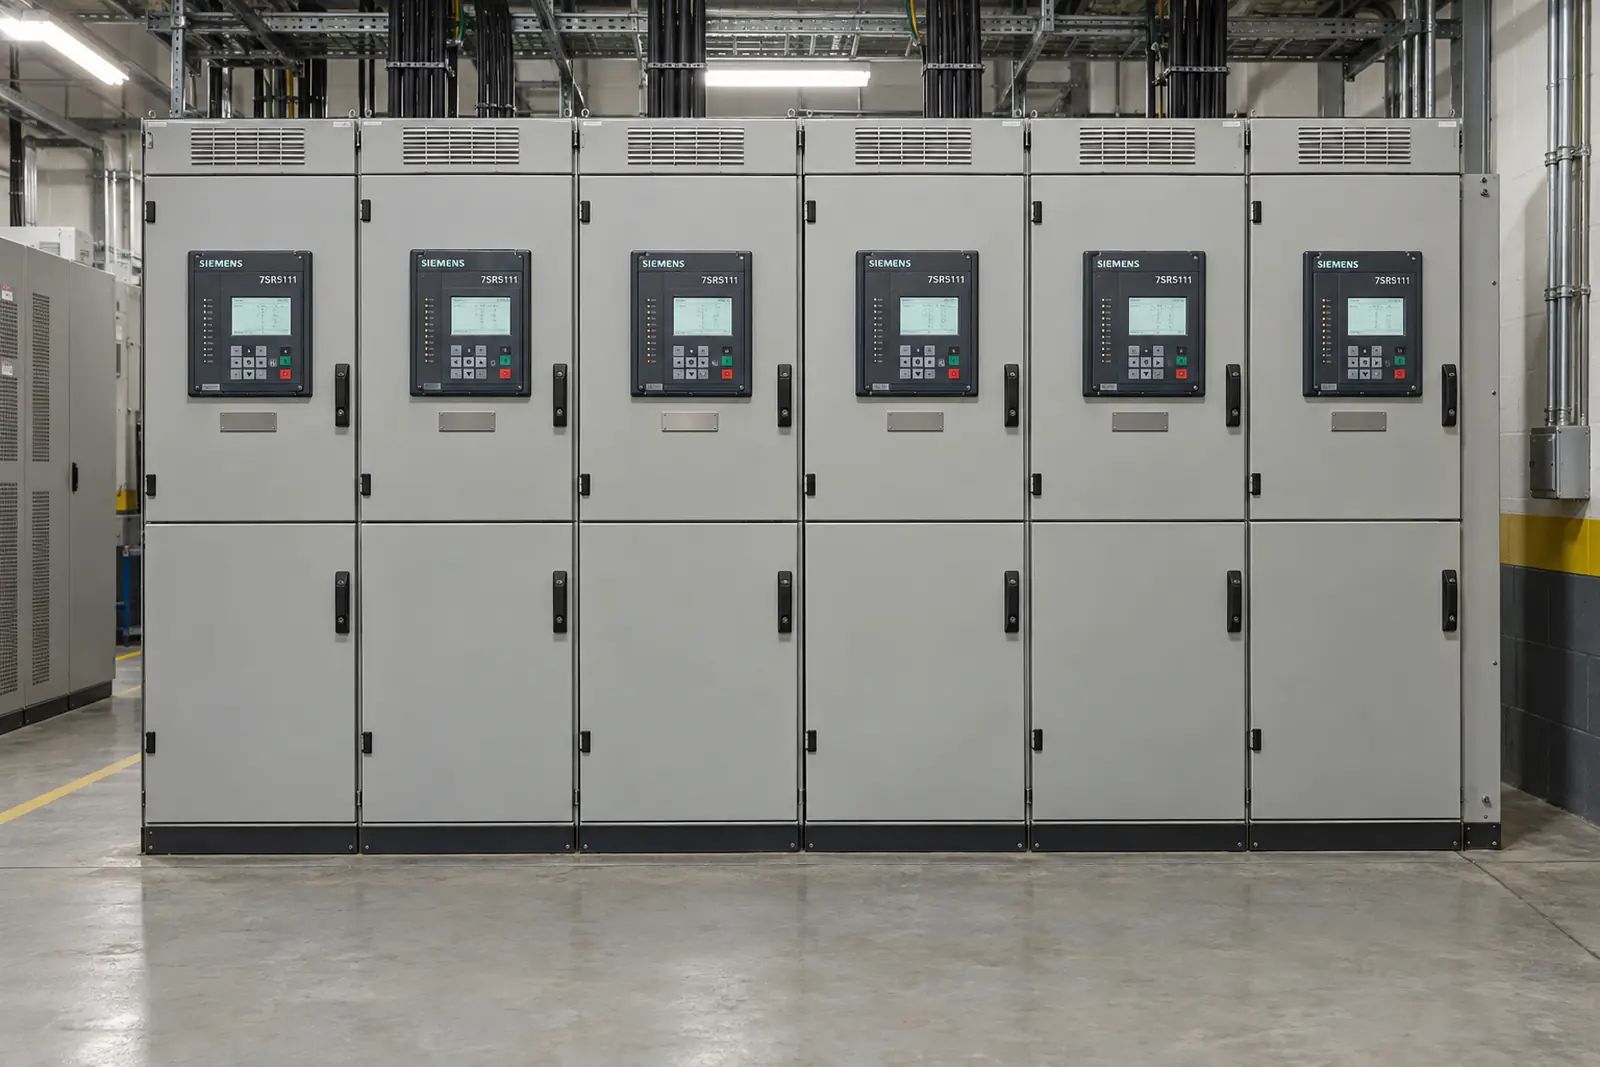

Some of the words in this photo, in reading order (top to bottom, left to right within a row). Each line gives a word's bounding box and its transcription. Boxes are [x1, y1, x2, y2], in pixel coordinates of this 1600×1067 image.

[199, 259, 243, 269] SIEMENS
[421, 258, 465, 269] SIEMENS
[643, 259, 685, 269] SIEMENS
[868, 259, 912, 269] SIEMENS
[1097, 259, 1140, 269] SIEMENS
[1317, 260, 1359, 270] SIEMENS
